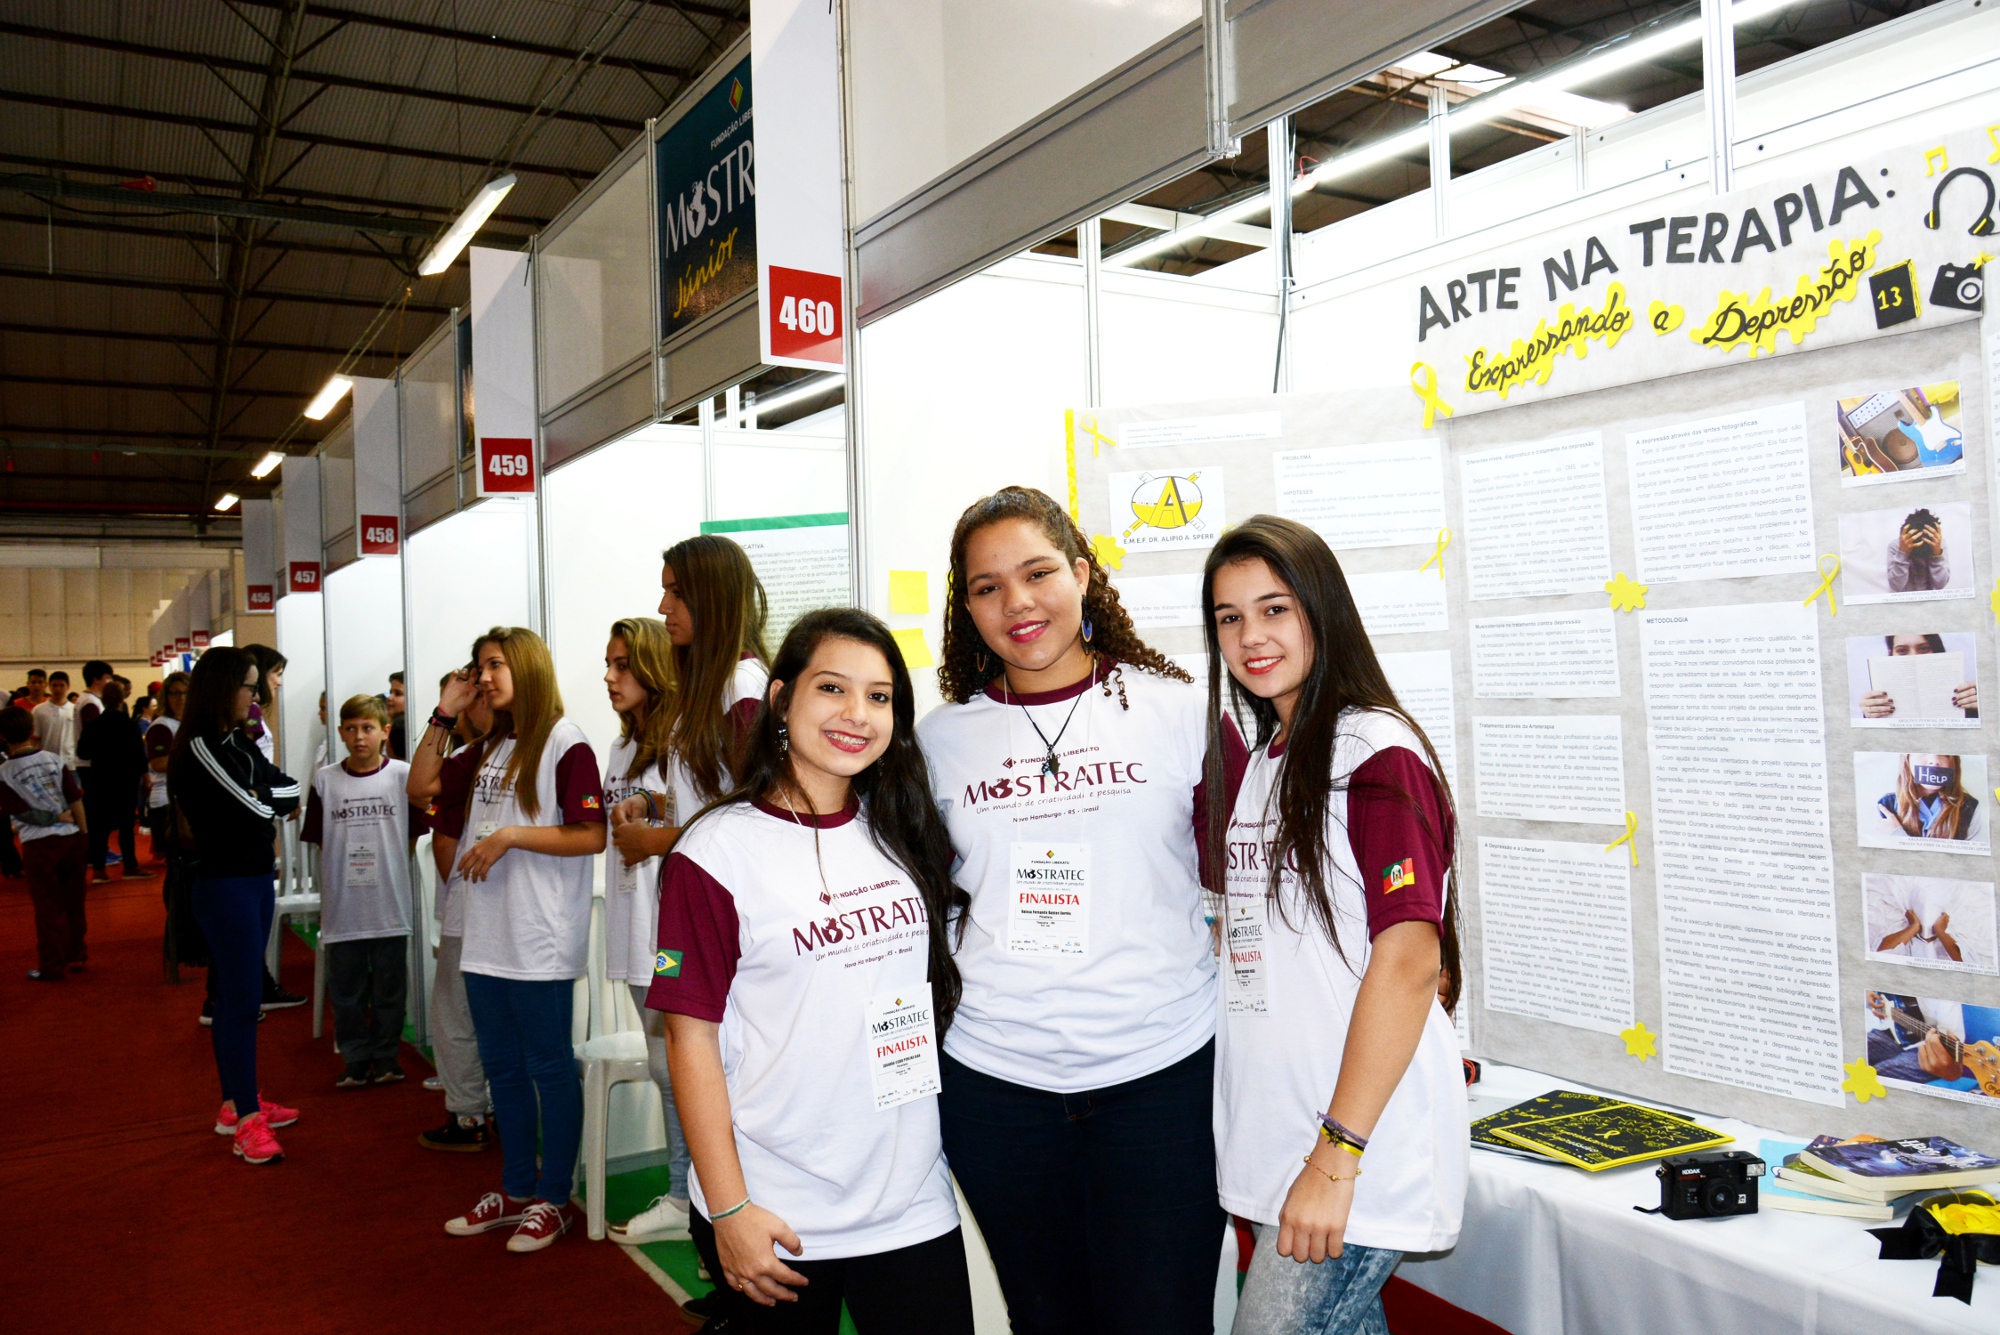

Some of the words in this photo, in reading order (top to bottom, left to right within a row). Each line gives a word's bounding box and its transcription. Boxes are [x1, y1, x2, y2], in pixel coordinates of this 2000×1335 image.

[711, 121, 738, 150] FUNDAÇÃO
[1419, 267, 1520, 342] ARTE
[1543, 236, 1619, 301] NA
[1629, 166, 1895, 267] TERAPIA:
[673, 227, 738, 318] Júnior
[1877, 286, 1902, 310] 13
[779, 296, 834, 336] 460
[1469, 292, 1630, 390] Expressando
[1653, 310, 1670, 330] a
[1703, 247, 1866, 344] Depressão
[1641, 435, 1669, 444] depressão
[1671, 431, 1690, 440] através
[1703, 426, 1721, 434] lentes
[1722, 420, 1758, 431] fotográficas
[1662, 444, 1677, 453] poder
[1744, 429, 1774, 438] momentos
[1569, 441, 1594, 450] depressão
[489, 455, 528, 476] 459
[366, 528, 394, 543] 458
[294, 571, 315, 583] 457
[251, 593, 269, 604] 456
[963, 761, 1147, 808] MOSTRATEC
[976, 806, 989, 815] Um
[993, 801, 1021, 810] mundo
[1038, 792, 1087, 805] criatividad
[1097, 787, 1131, 798] pesquisa
[331, 805, 397, 820] MOSTRATEC
[1030, 811, 1062, 820] Hamburgo
[1489, 842, 1512, 850] Depressão
[870, 879, 900, 890] LIBERATO
[1016, 868, 1084, 880] MOSTRATEC
[1019, 893, 1080, 905] FINALISTA
[828, 946, 852, 957] mundo
[862, 931, 903, 949] criatividade
[899, 945, 912, 955] Brasil
[872, 1009, 929, 1034] MOSTRATEC
[877, 1035, 928, 1058] FINALISTA
[1688, 1066, 1699, 1075] com
[1708, 1072, 1723, 1080] níveis
[1735, 1077, 1745, 1086] que
